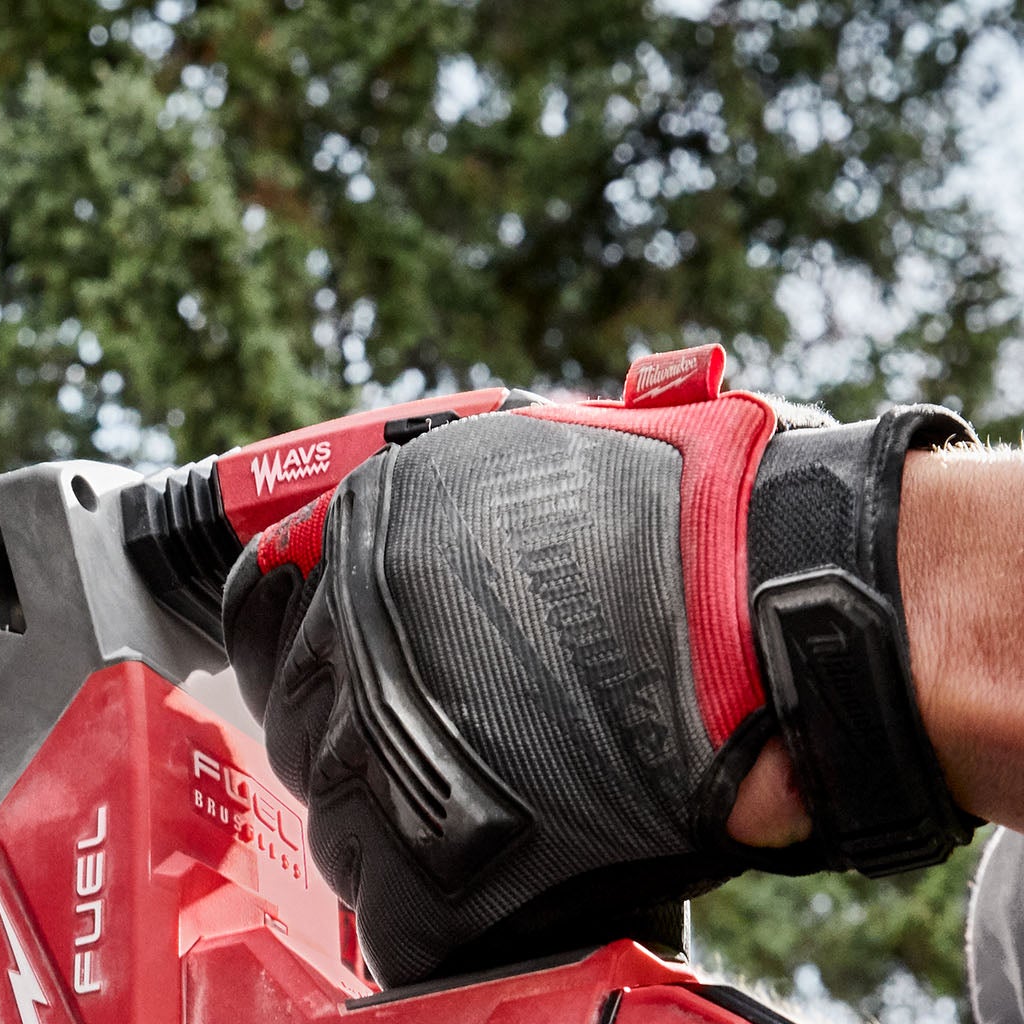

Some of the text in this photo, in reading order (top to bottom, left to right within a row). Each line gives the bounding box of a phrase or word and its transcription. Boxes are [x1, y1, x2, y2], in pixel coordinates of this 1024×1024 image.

[636, 356, 697, 392] Milwaukee
[193, 750, 298, 851] FUEL
[74, 806, 108, 995] FUEL
